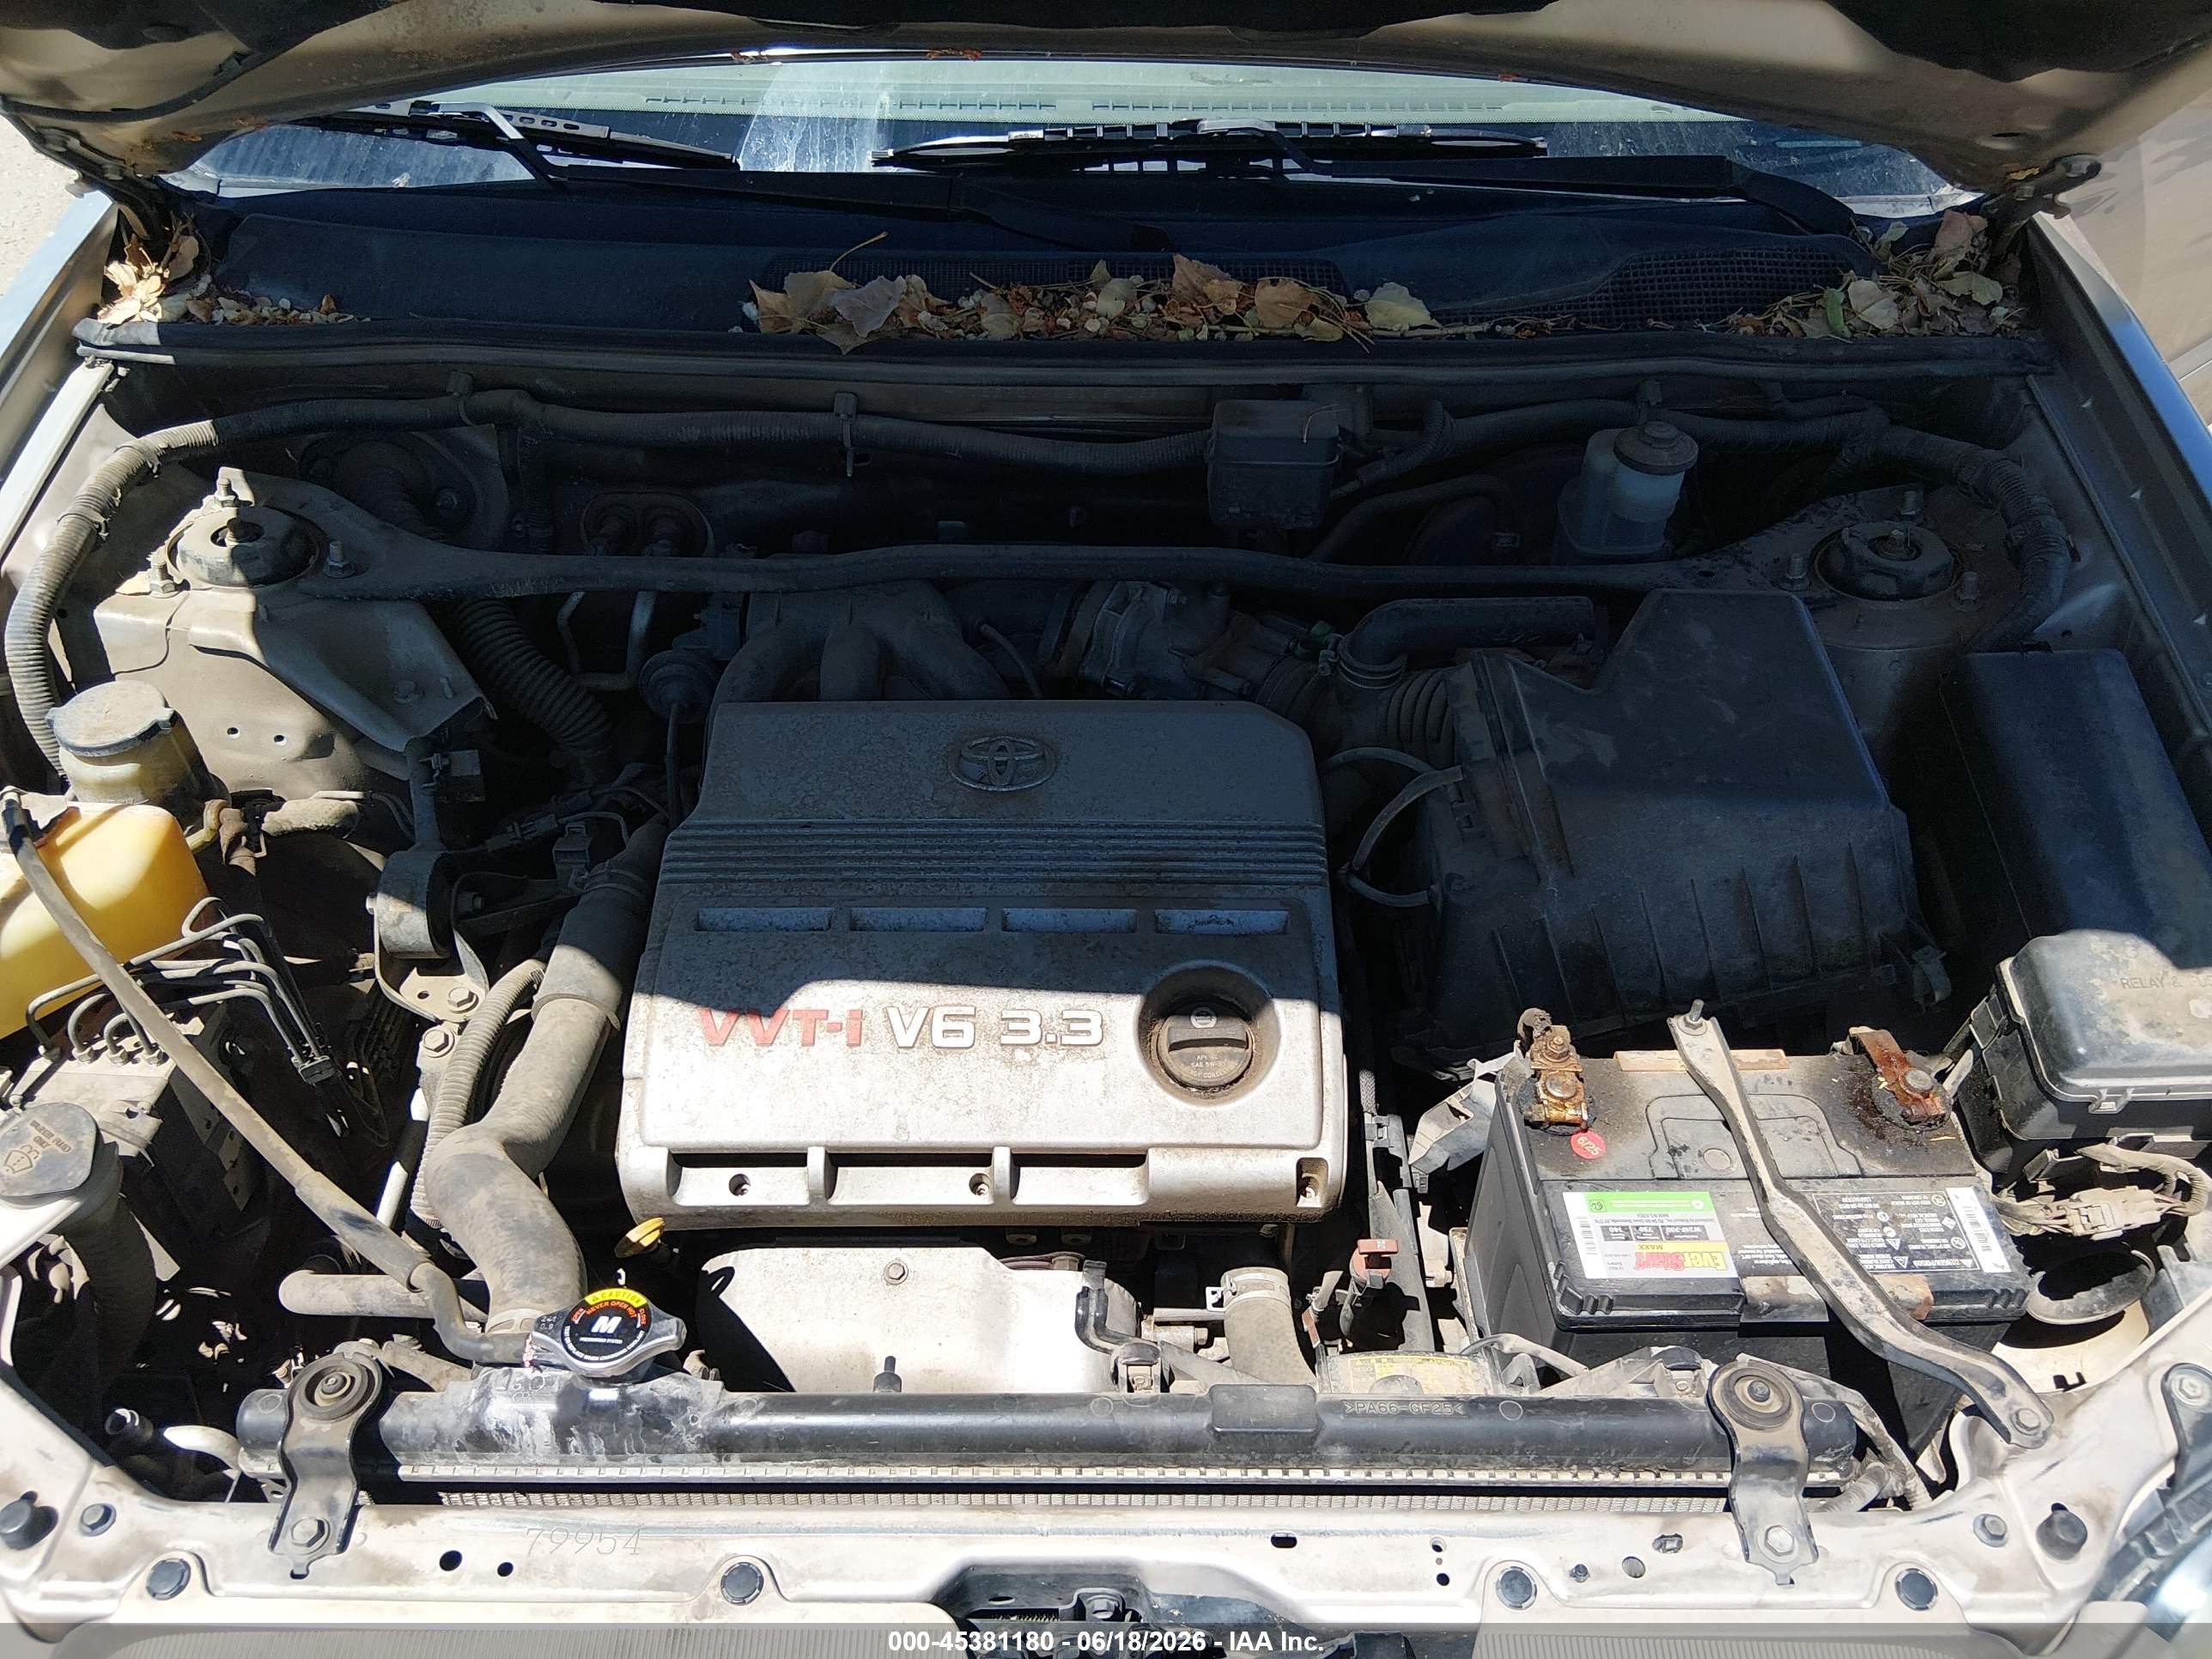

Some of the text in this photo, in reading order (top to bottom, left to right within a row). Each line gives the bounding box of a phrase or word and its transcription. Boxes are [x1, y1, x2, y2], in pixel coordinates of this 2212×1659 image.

[2120, 975, 2165, 989] RELAY
[885, 1006, 977, 1049] V6
[1000, 1008, 1104, 1047] 3.3
[1577, 1136, 1602, 1156] 6/25
[1635, 1252, 1728, 1271] EverStart
[601, 1291, 641, 1304] CAUTION
[586, 1301, 610, 1316] NEVER
[611, 1301, 627, 1310] OPEN
[525, 1523, 642, 1555] 79954
